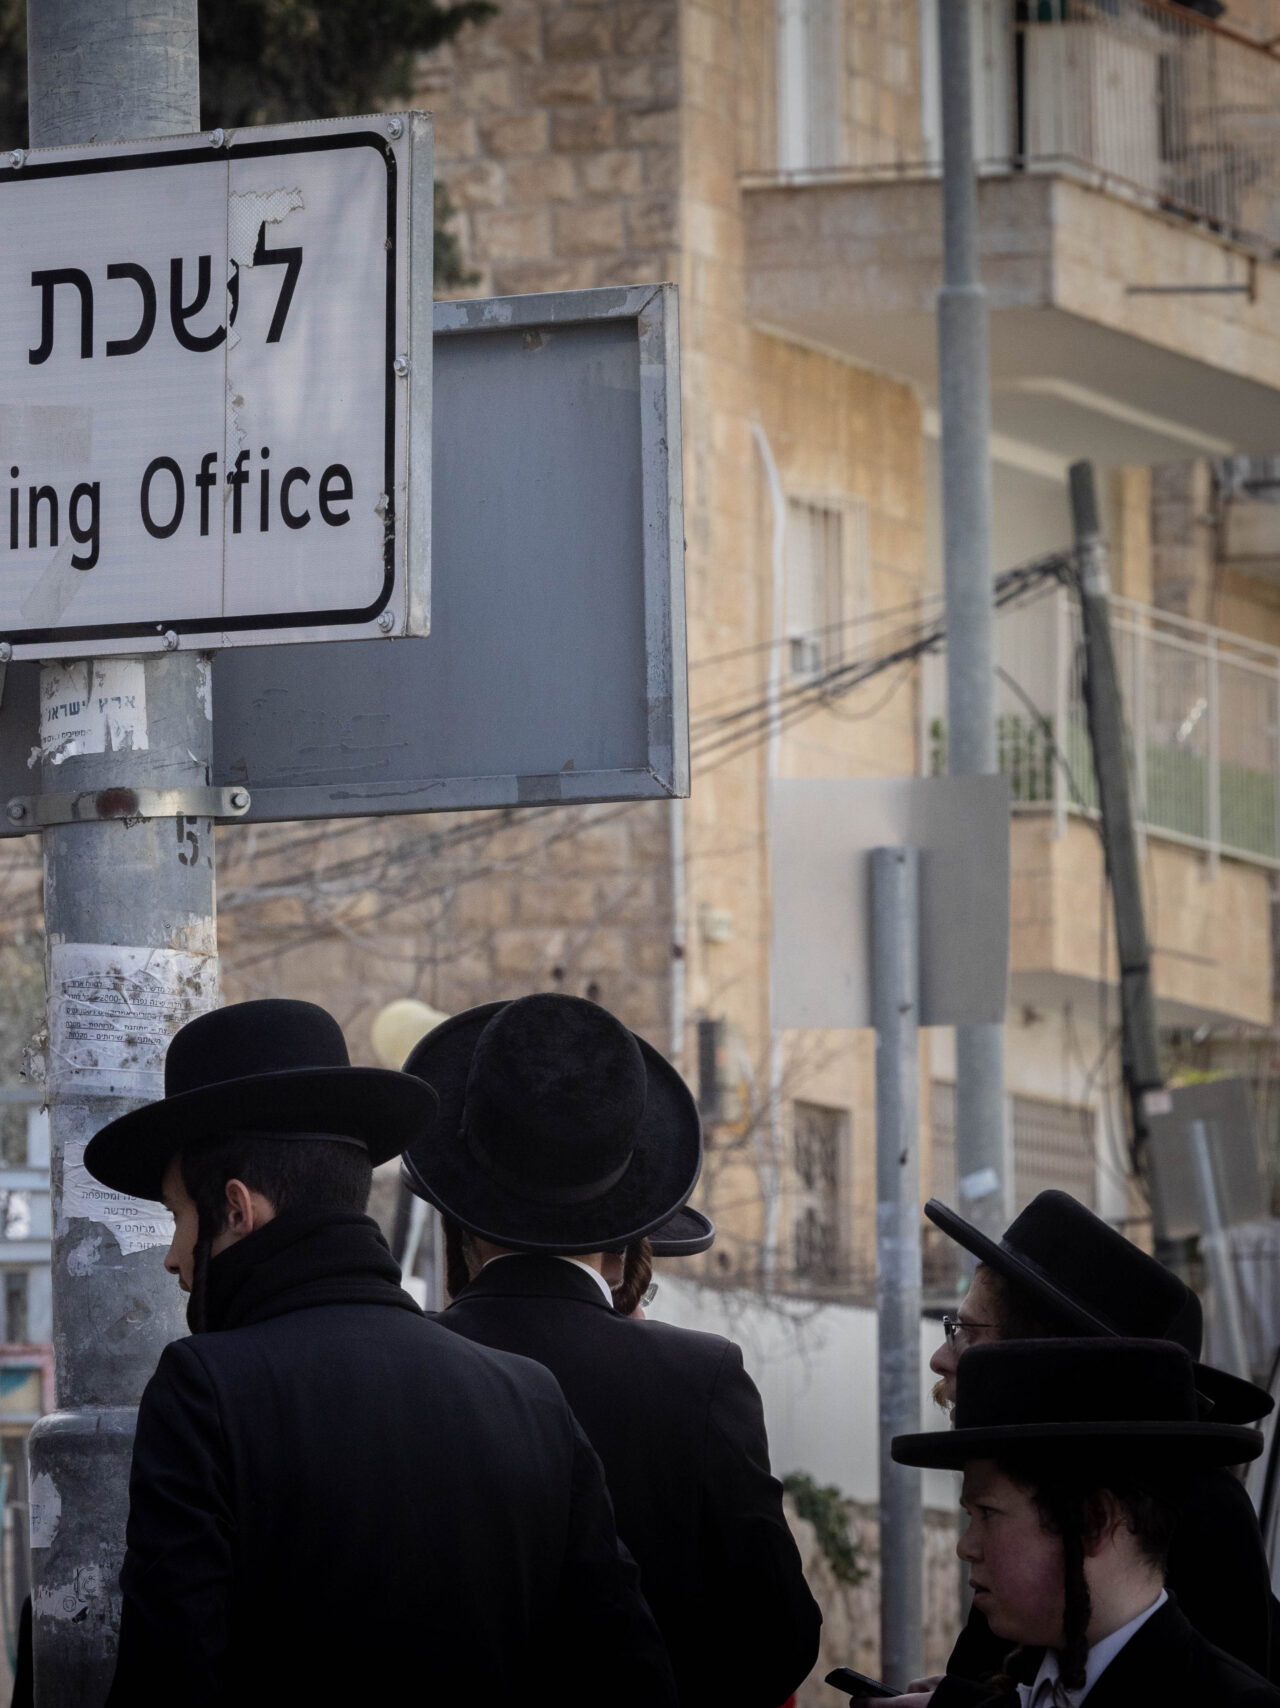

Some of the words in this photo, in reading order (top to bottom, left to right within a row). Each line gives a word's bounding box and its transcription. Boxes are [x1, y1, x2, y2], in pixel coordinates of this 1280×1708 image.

[28, 220, 304, 366] לשכת
[141, 447, 355, 541] Office
[98, 695, 136, 714] ארץ
